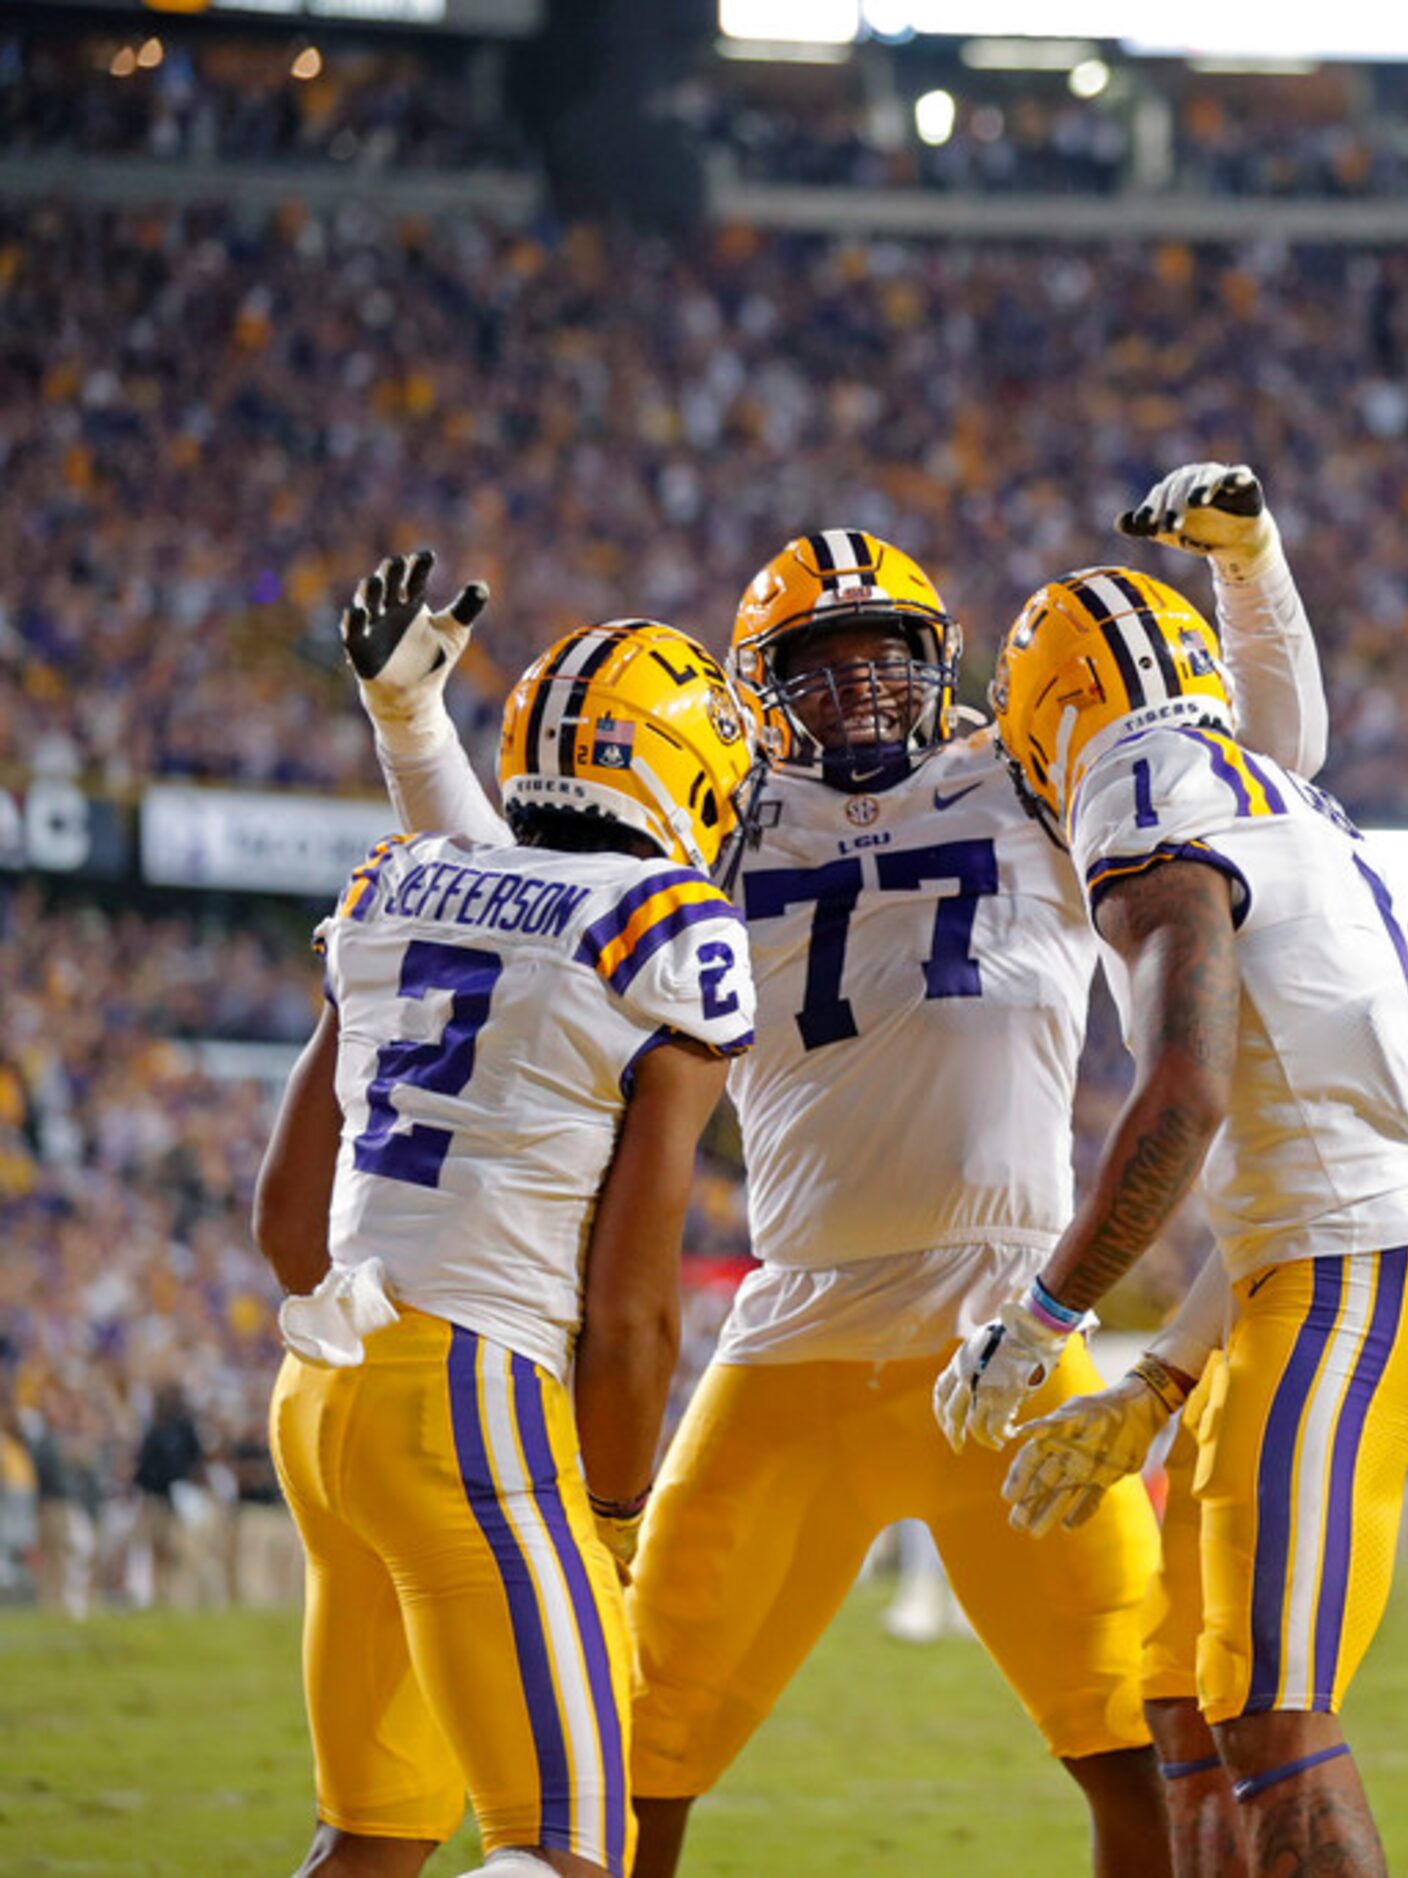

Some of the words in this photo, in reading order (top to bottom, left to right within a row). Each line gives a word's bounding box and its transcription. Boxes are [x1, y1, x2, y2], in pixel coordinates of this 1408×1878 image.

[1125, 703, 1198, 732] TIGERS
[516, 780, 585, 798] TIGERS
[1132, 759, 1159, 829] 1
[384, 862, 591, 938] JEFFERSON
[697, 941, 739, 1020] 2
[743, 838, 998, 1051] 77
[353, 940, 503, 1188] 2
